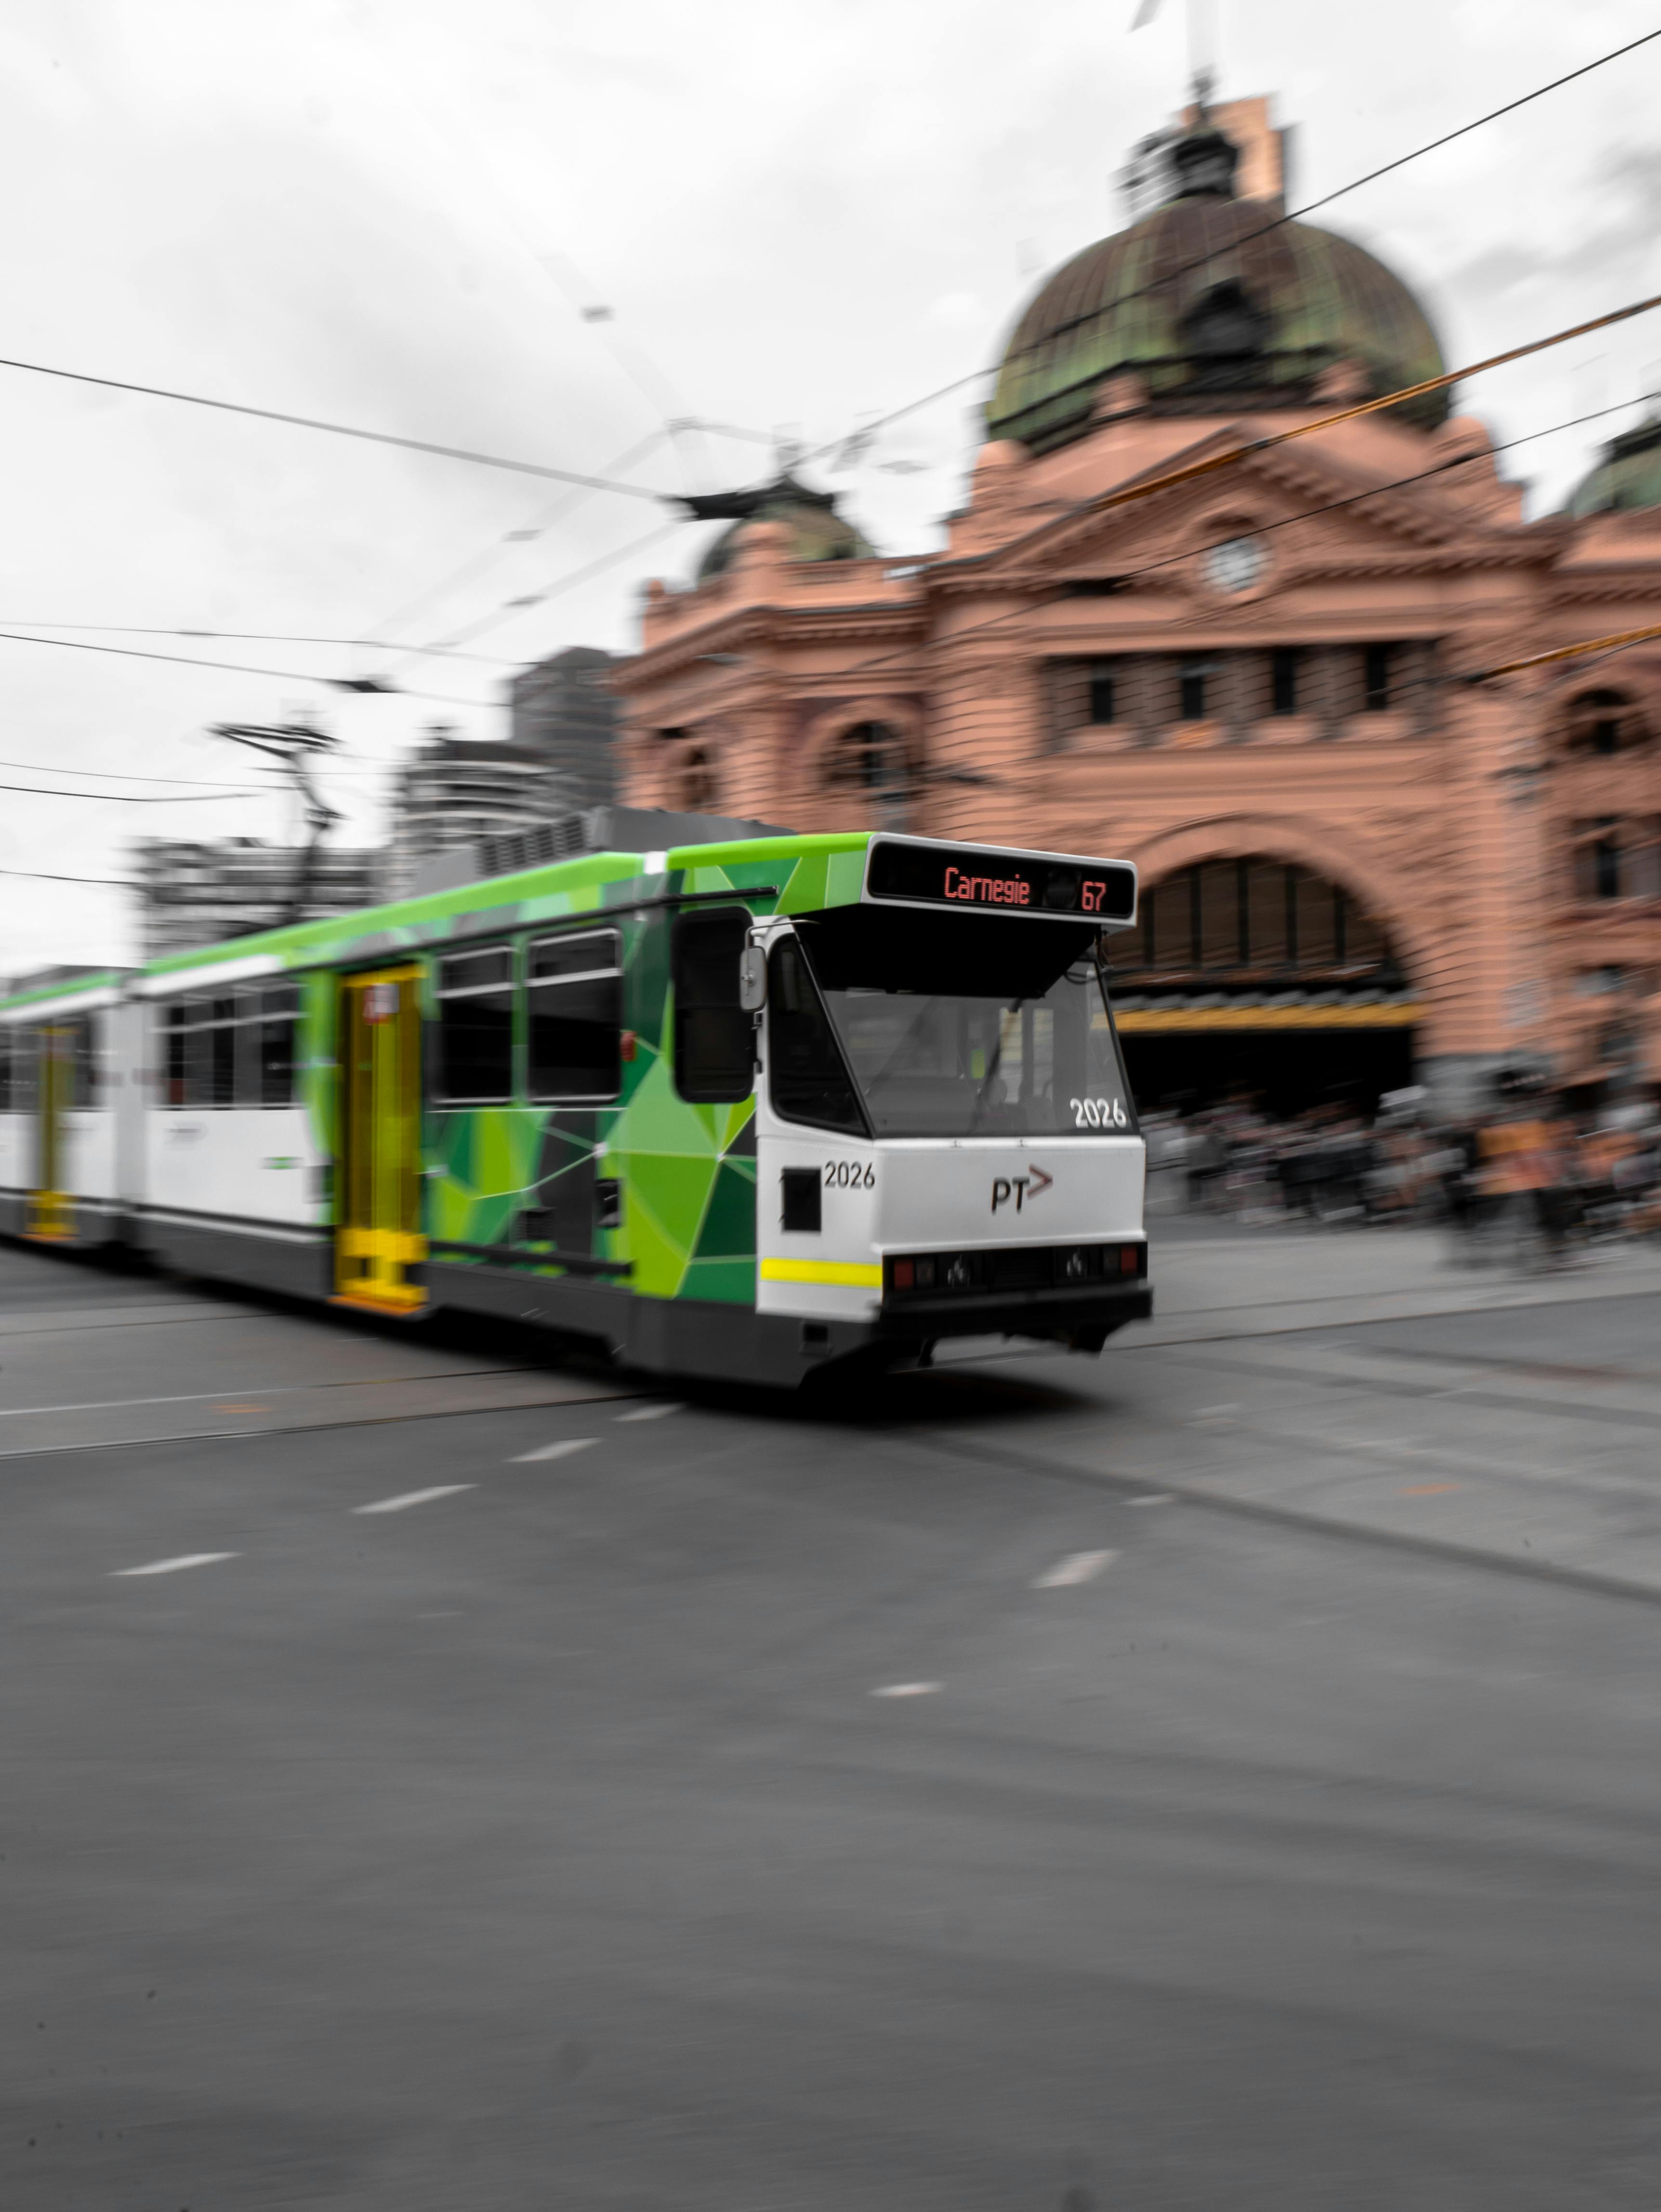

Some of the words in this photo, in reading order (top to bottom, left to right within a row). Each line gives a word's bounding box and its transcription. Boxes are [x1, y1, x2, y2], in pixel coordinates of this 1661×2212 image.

[944, 867, 1030, 904] Carnegie
[1081, 882, 1106, 911] 67
[1070, 1098, 1126, 1128] 2026
[824, 1160, 875, 1190] 2026
